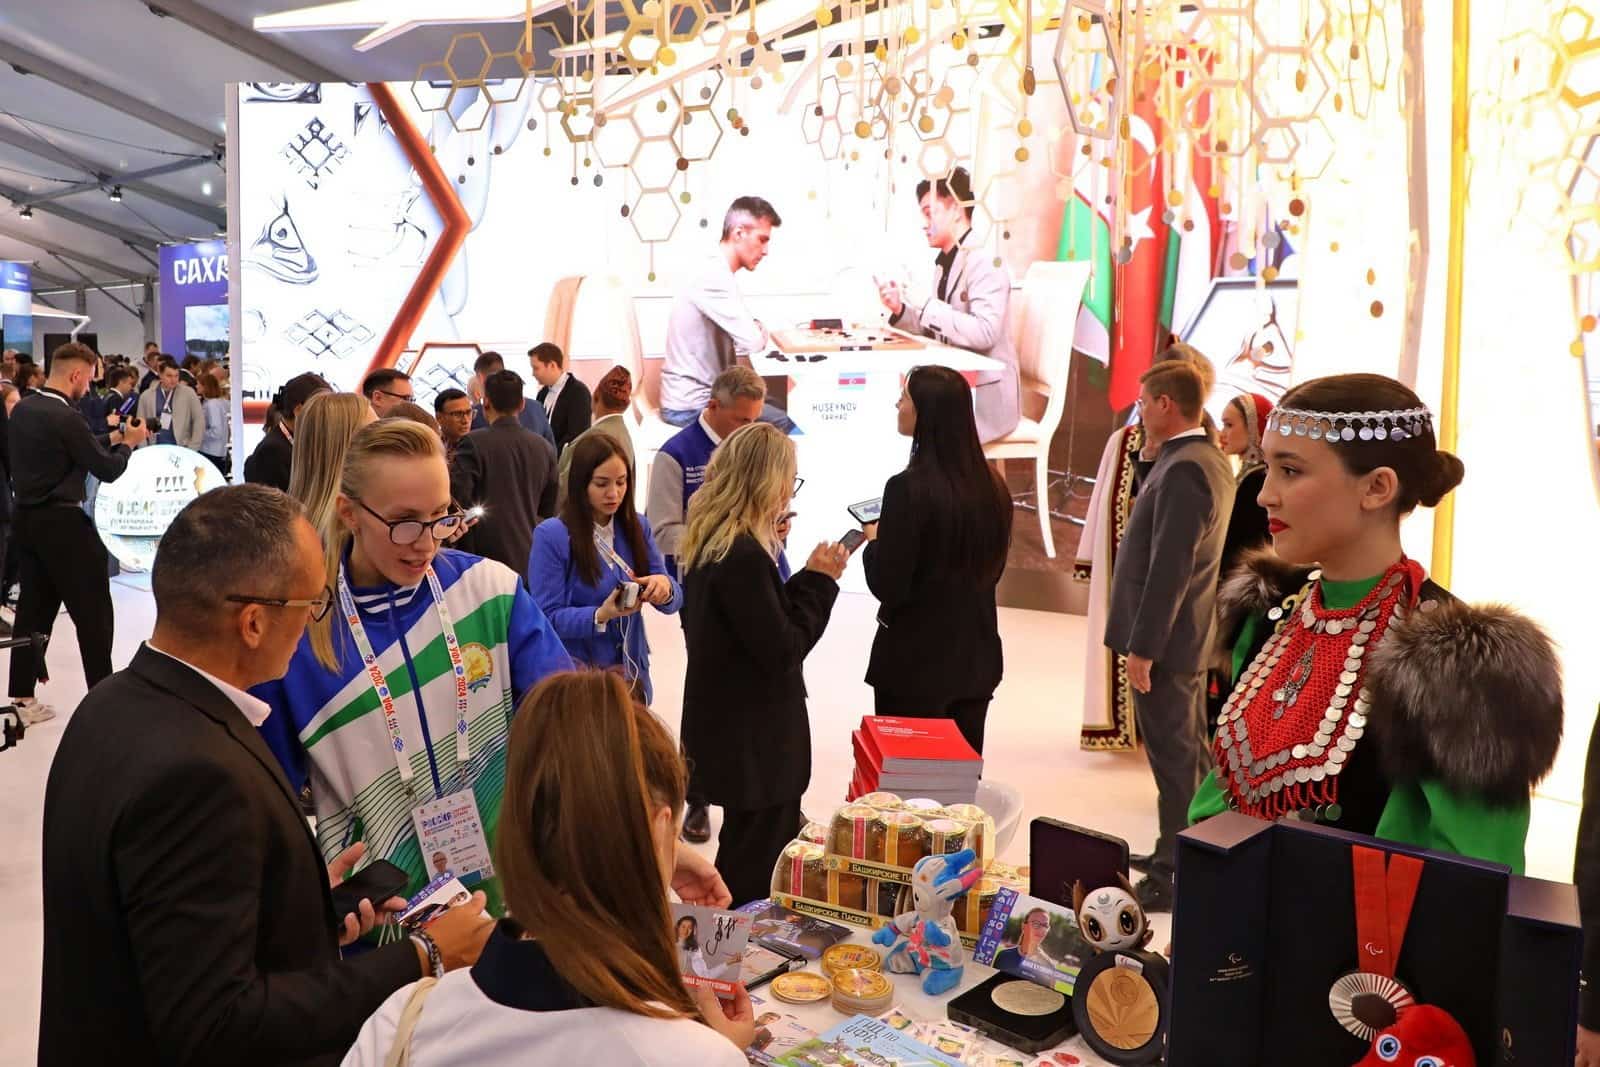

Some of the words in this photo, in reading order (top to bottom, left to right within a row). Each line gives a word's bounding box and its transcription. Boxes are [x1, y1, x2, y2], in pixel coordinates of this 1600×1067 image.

[173, 255, 229, 285] САХА
[368, 665, 385, 687] 2024
[449, 646, 462, 665] УФА
[457, 676, 468, 697] 2024
[852, 863, 900, 880] БАШКИРСКИЕ
[795, 902, 840, 919] БАШКИРСКИЕ
